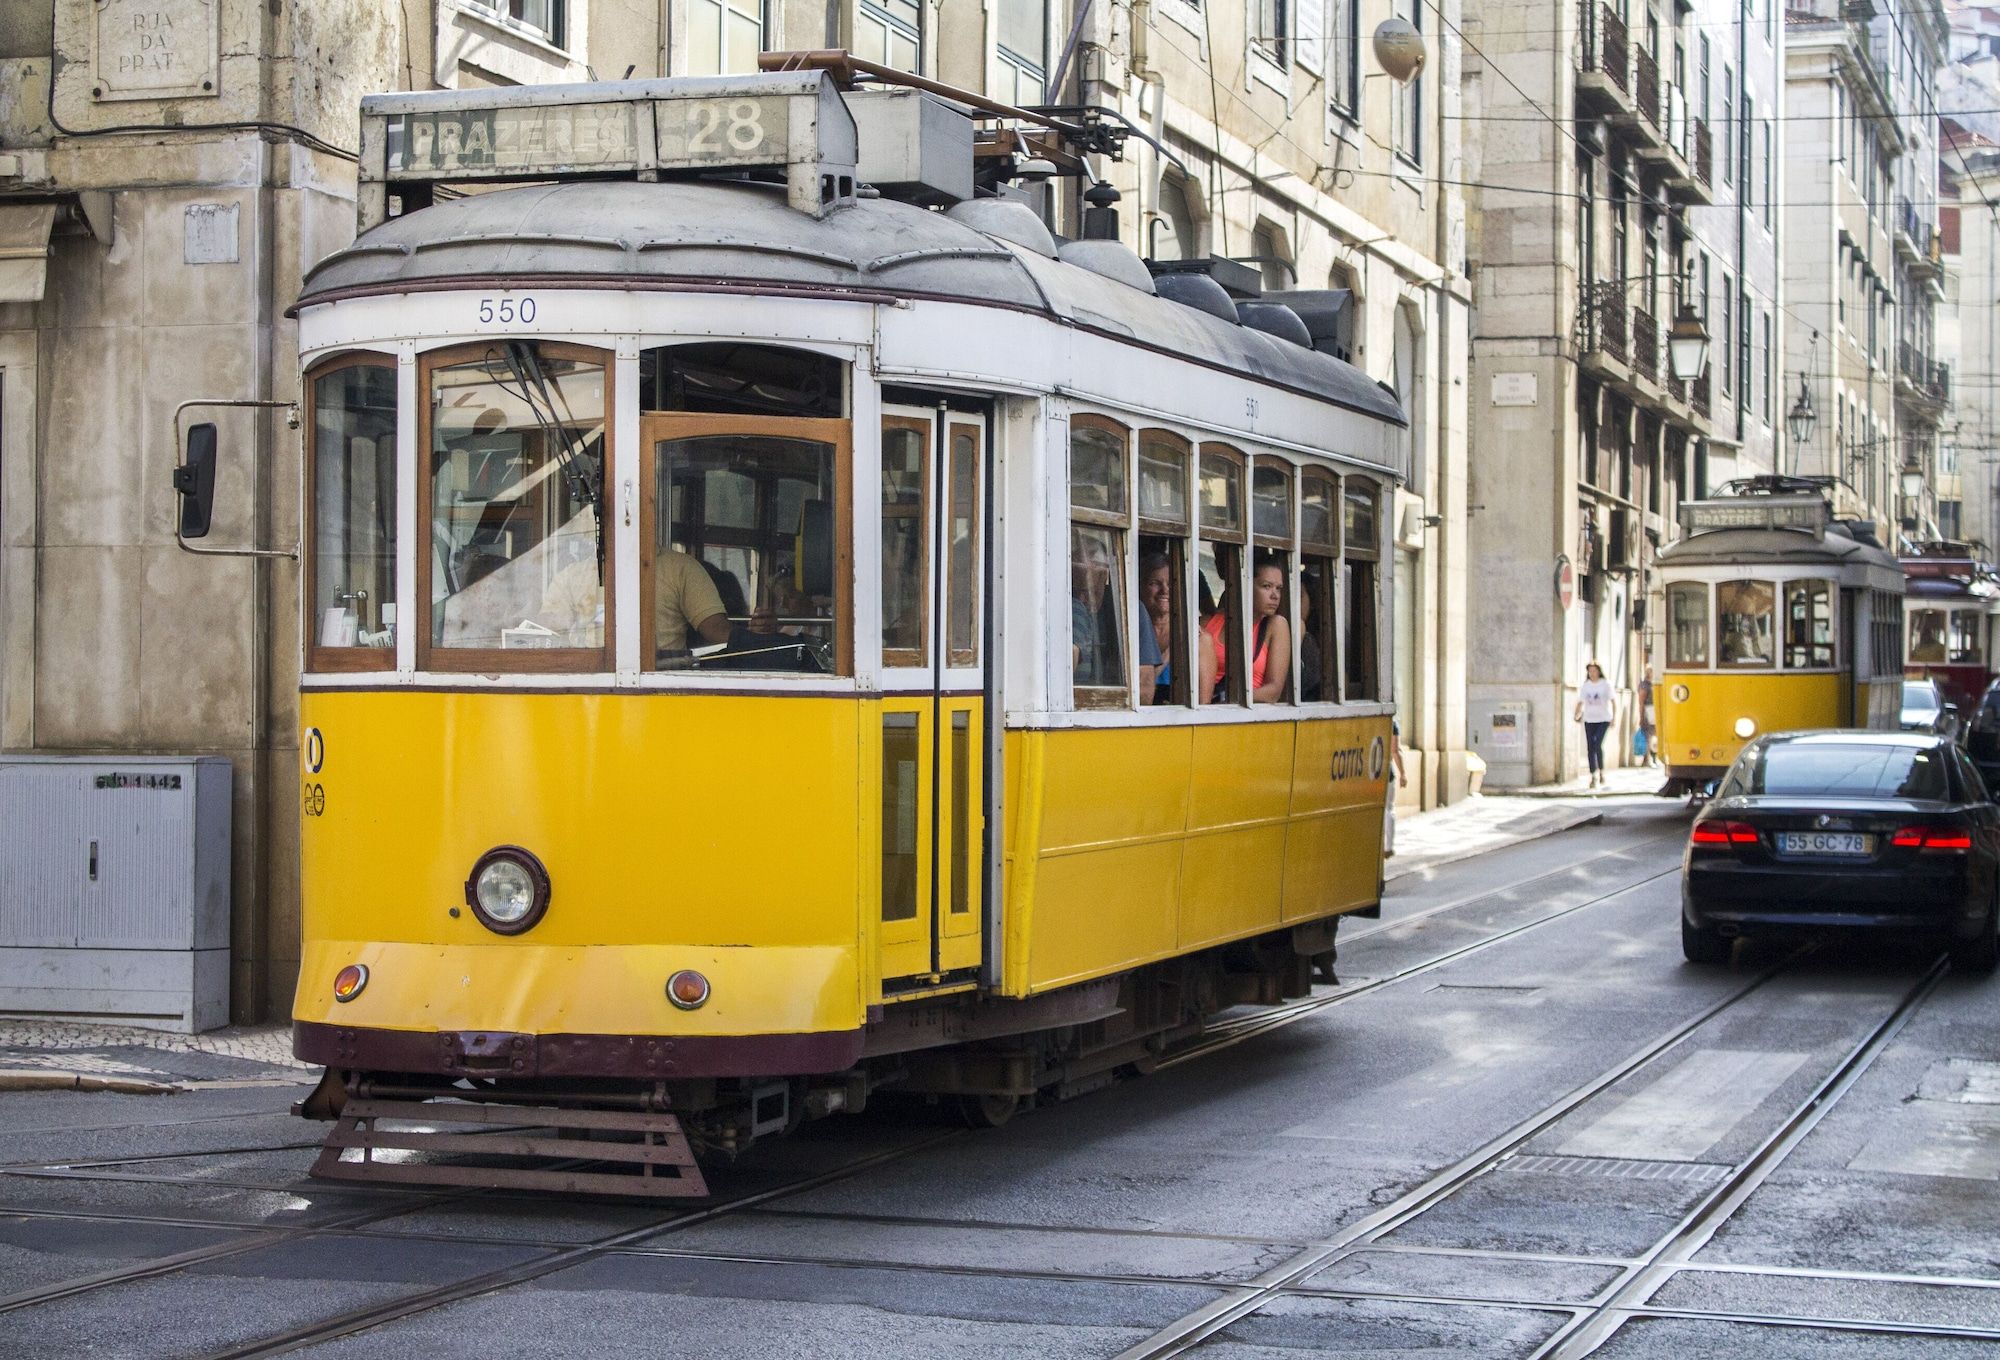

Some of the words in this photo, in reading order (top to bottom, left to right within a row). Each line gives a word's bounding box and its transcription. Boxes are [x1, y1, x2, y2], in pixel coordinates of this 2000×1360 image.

[133, 13, 174, 31] RUA
[141, 34, 167, 50] DA
[411, 117, 625, 156] PRAZERES
[687, 100, 763, 151] 28
[479, 297, 536, 323] 550
[1695, 514, 1761, 526] PRAZERES
[1331, 735, 1364, 781] carris
